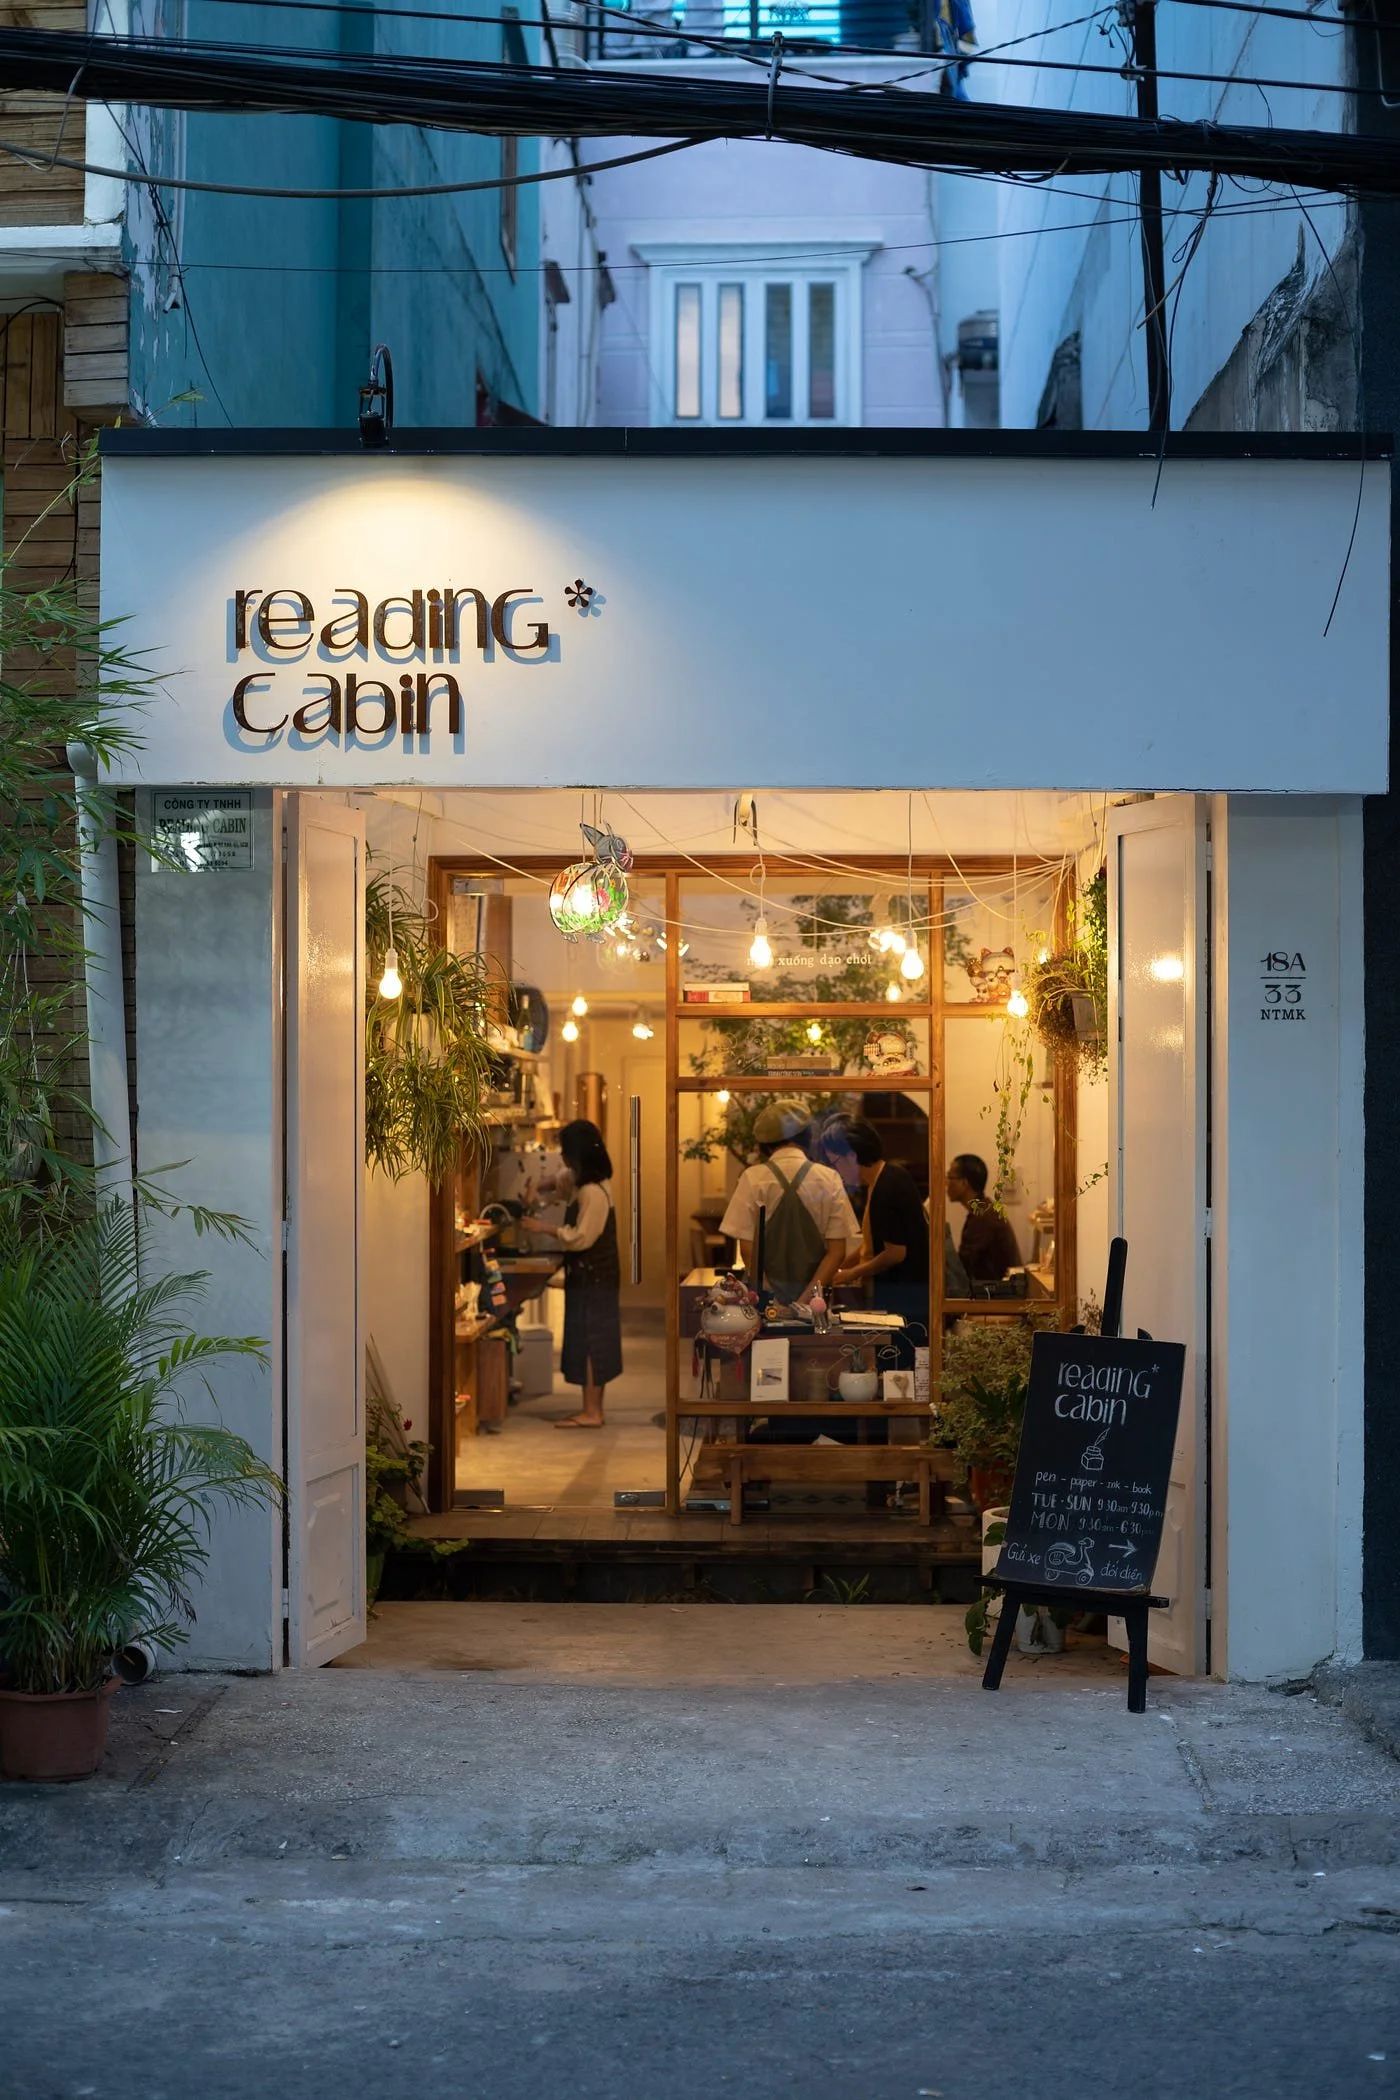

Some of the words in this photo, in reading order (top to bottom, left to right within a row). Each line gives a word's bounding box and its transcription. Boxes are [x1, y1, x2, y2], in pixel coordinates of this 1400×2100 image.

[233, 672, 460, 734] cabin
[164, 798, 194, 809] CÔNG
[198, 799, 210, 809] TY
[214, 799, 241, 809] TNHH
[213, 818, 247, 833] CABIN
[778, 953, 814, 968] xuống
[820, 953, 841, 968] dạo
[1260, 951, 1306, 971] 18A
[1264, 984, 1302, 1004] 33
[1260, 1009, 1306, 1020] NTMK
[1054, 1394, 1127, 1426] cabin
[1035, 1471, 1057, 1486] pen
[1069, 1477, 1097, 1492] paper
[1132, 1482, 1153, 1494] book
[1031, 1511, 1070, 1531] MON
[1027, 1553, 1041, 1565] xe
